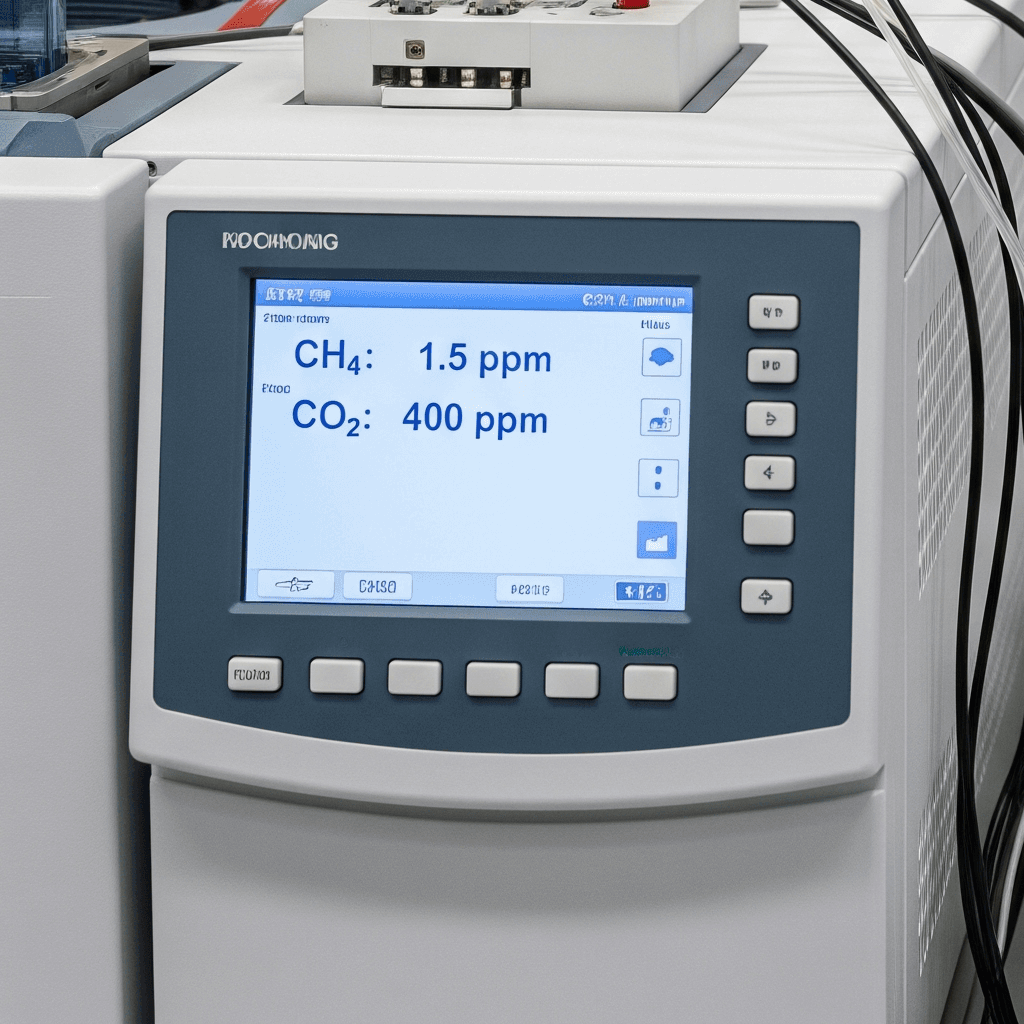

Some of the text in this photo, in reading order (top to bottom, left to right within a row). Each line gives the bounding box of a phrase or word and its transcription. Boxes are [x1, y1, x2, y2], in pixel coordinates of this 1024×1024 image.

[419, 341, 467, 371] 1.5
[479, 350, 551, 379] ppm
[402, 402, 463, 432] 400
[475, 411, 547, 441] ppm
